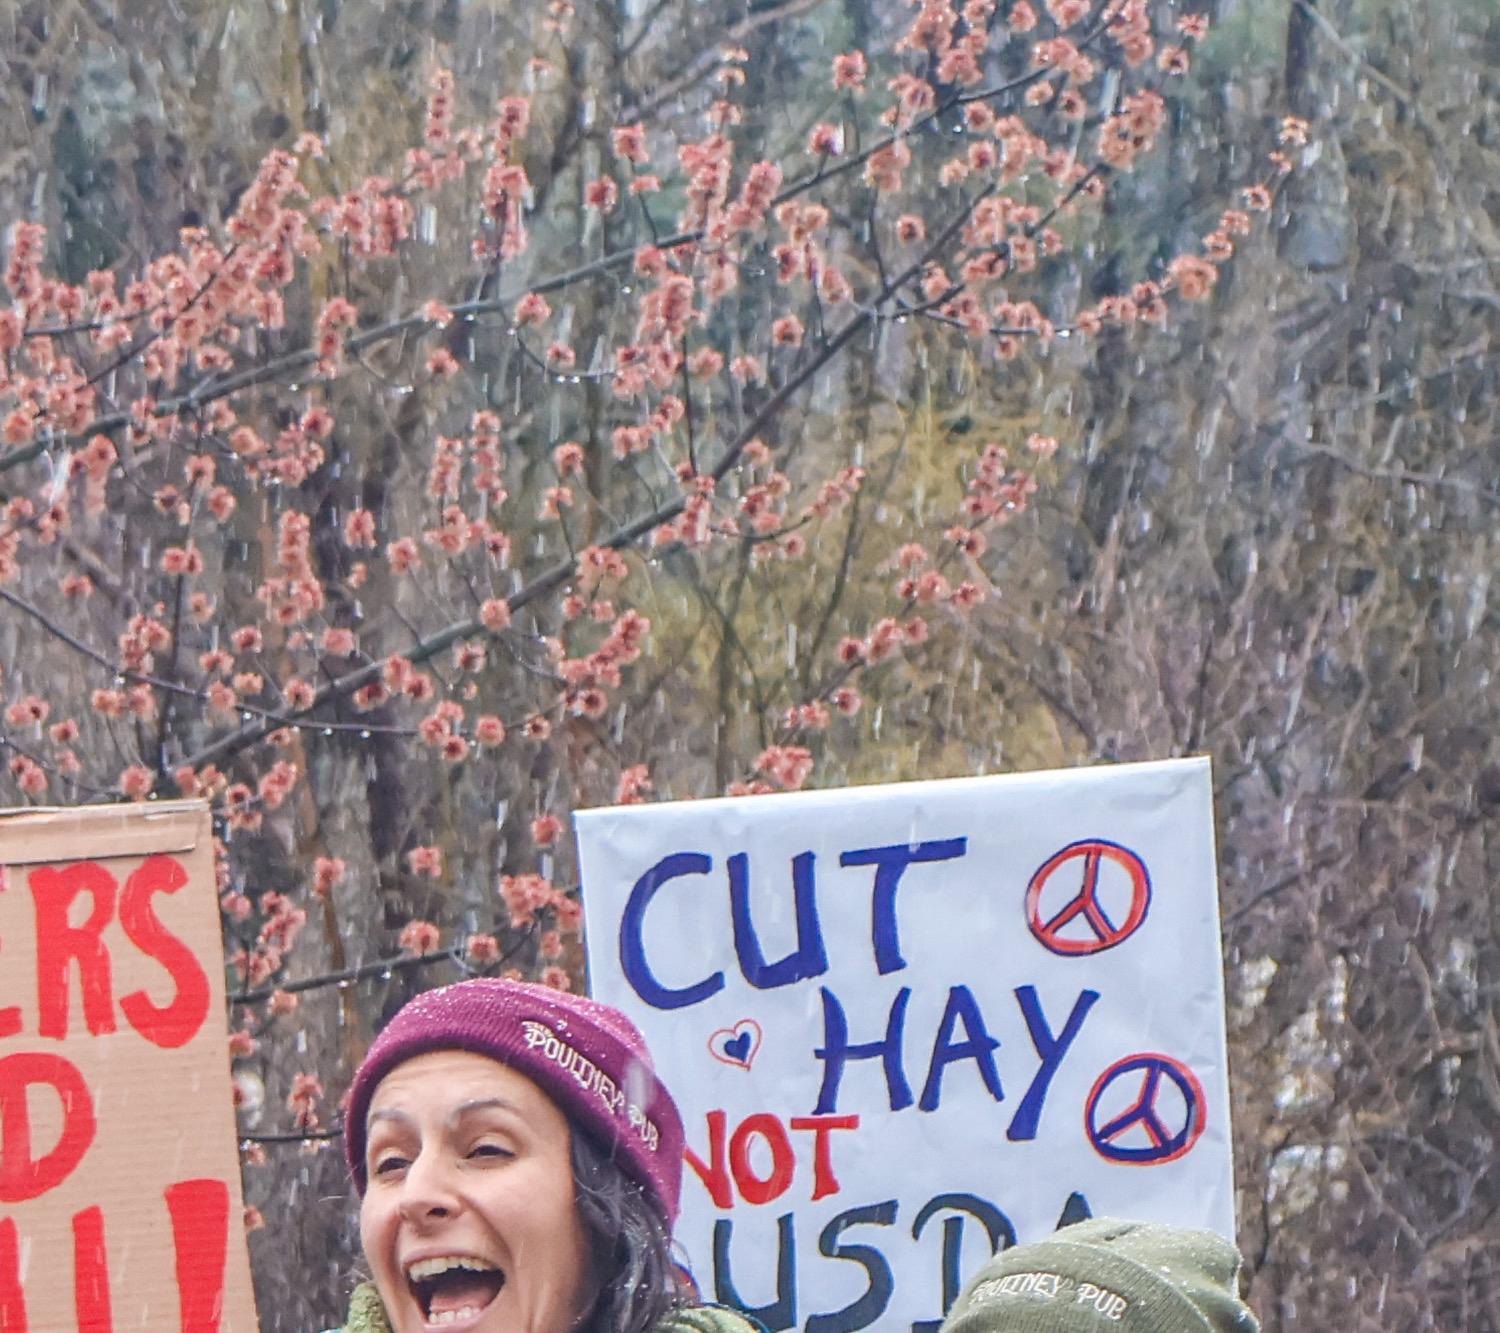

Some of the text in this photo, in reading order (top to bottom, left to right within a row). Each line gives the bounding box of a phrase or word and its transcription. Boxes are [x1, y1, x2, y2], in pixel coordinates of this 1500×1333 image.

[619, 836, 968, 1010] CUT
[814, 985, 1100, 1141] HAY
[628, 1104, 661, 1151] PUB
[683, 1110, 861, 1209] NOT
[1076, 1283, 1129, 1321] PUB
